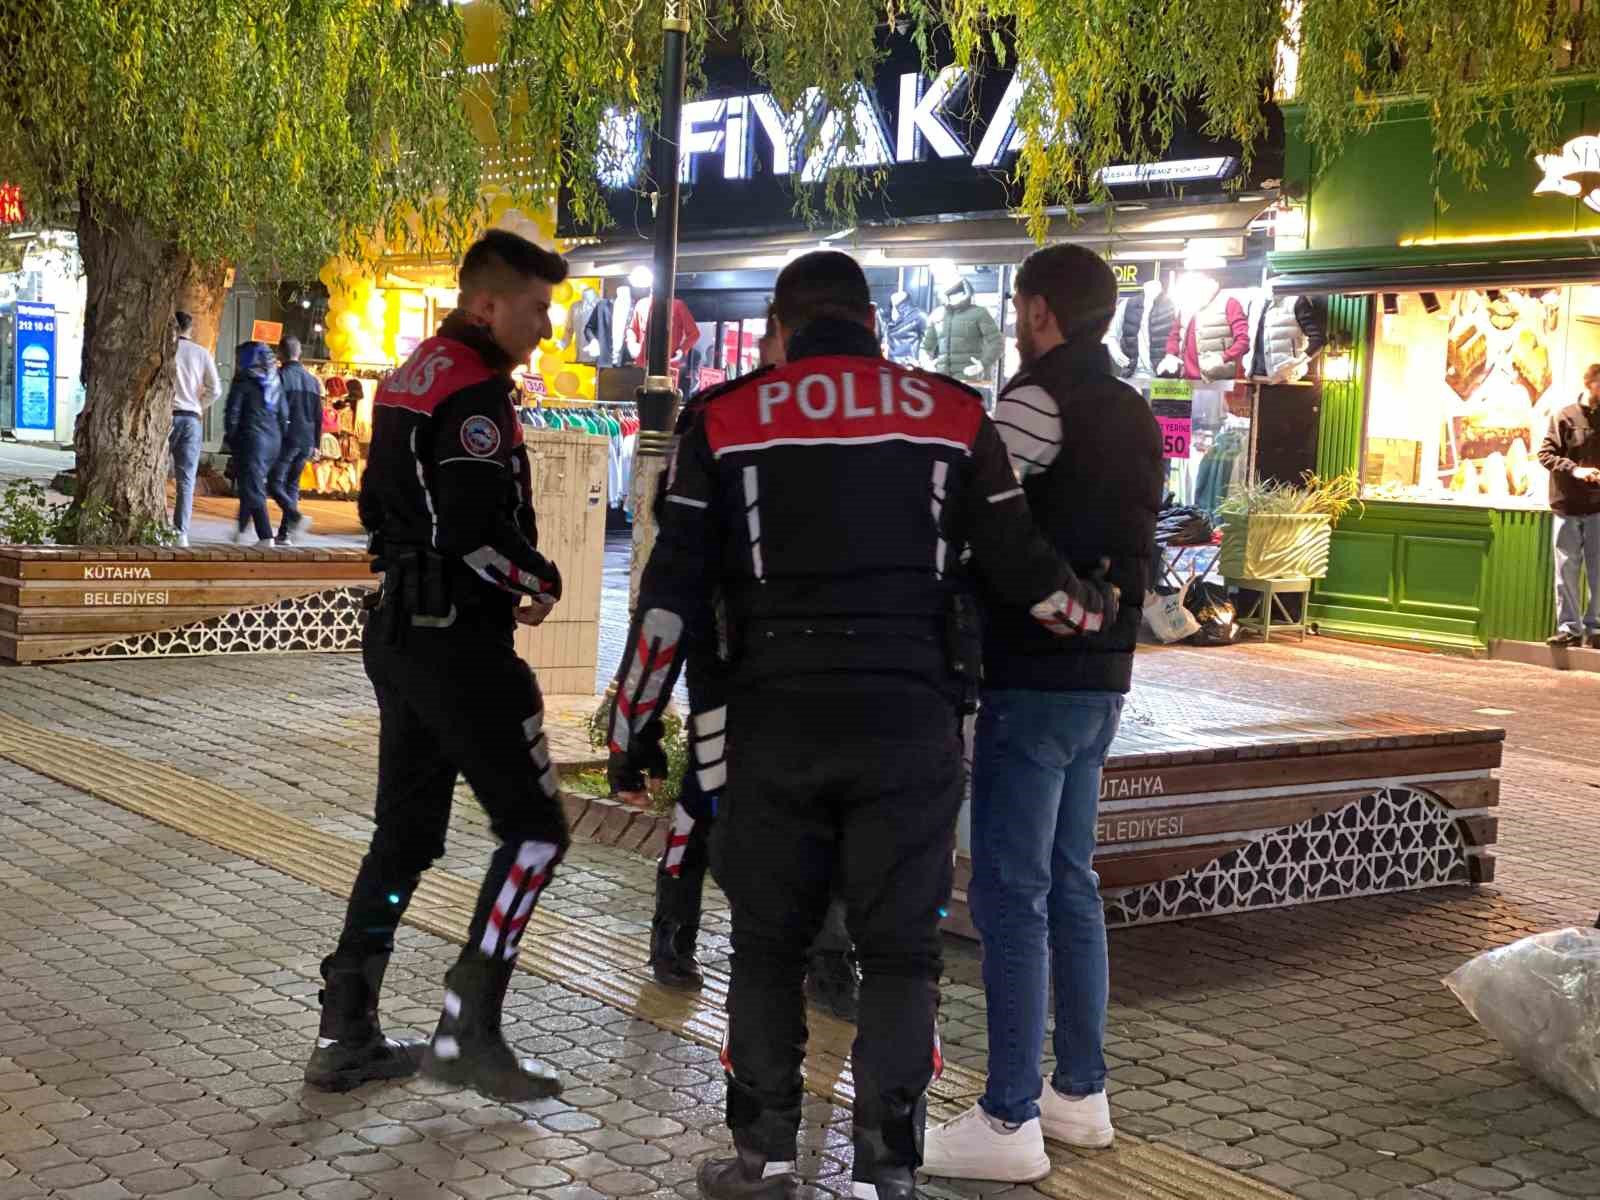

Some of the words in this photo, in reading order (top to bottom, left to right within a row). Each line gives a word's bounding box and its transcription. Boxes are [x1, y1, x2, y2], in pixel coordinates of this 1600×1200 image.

[18, 320, 33, 331] 212
[757, 366, 935, 425] POLİS
[83, 565, 152, 580] KÜTAHYA
[84, 589, 169, 605] BELEDİYESİ
